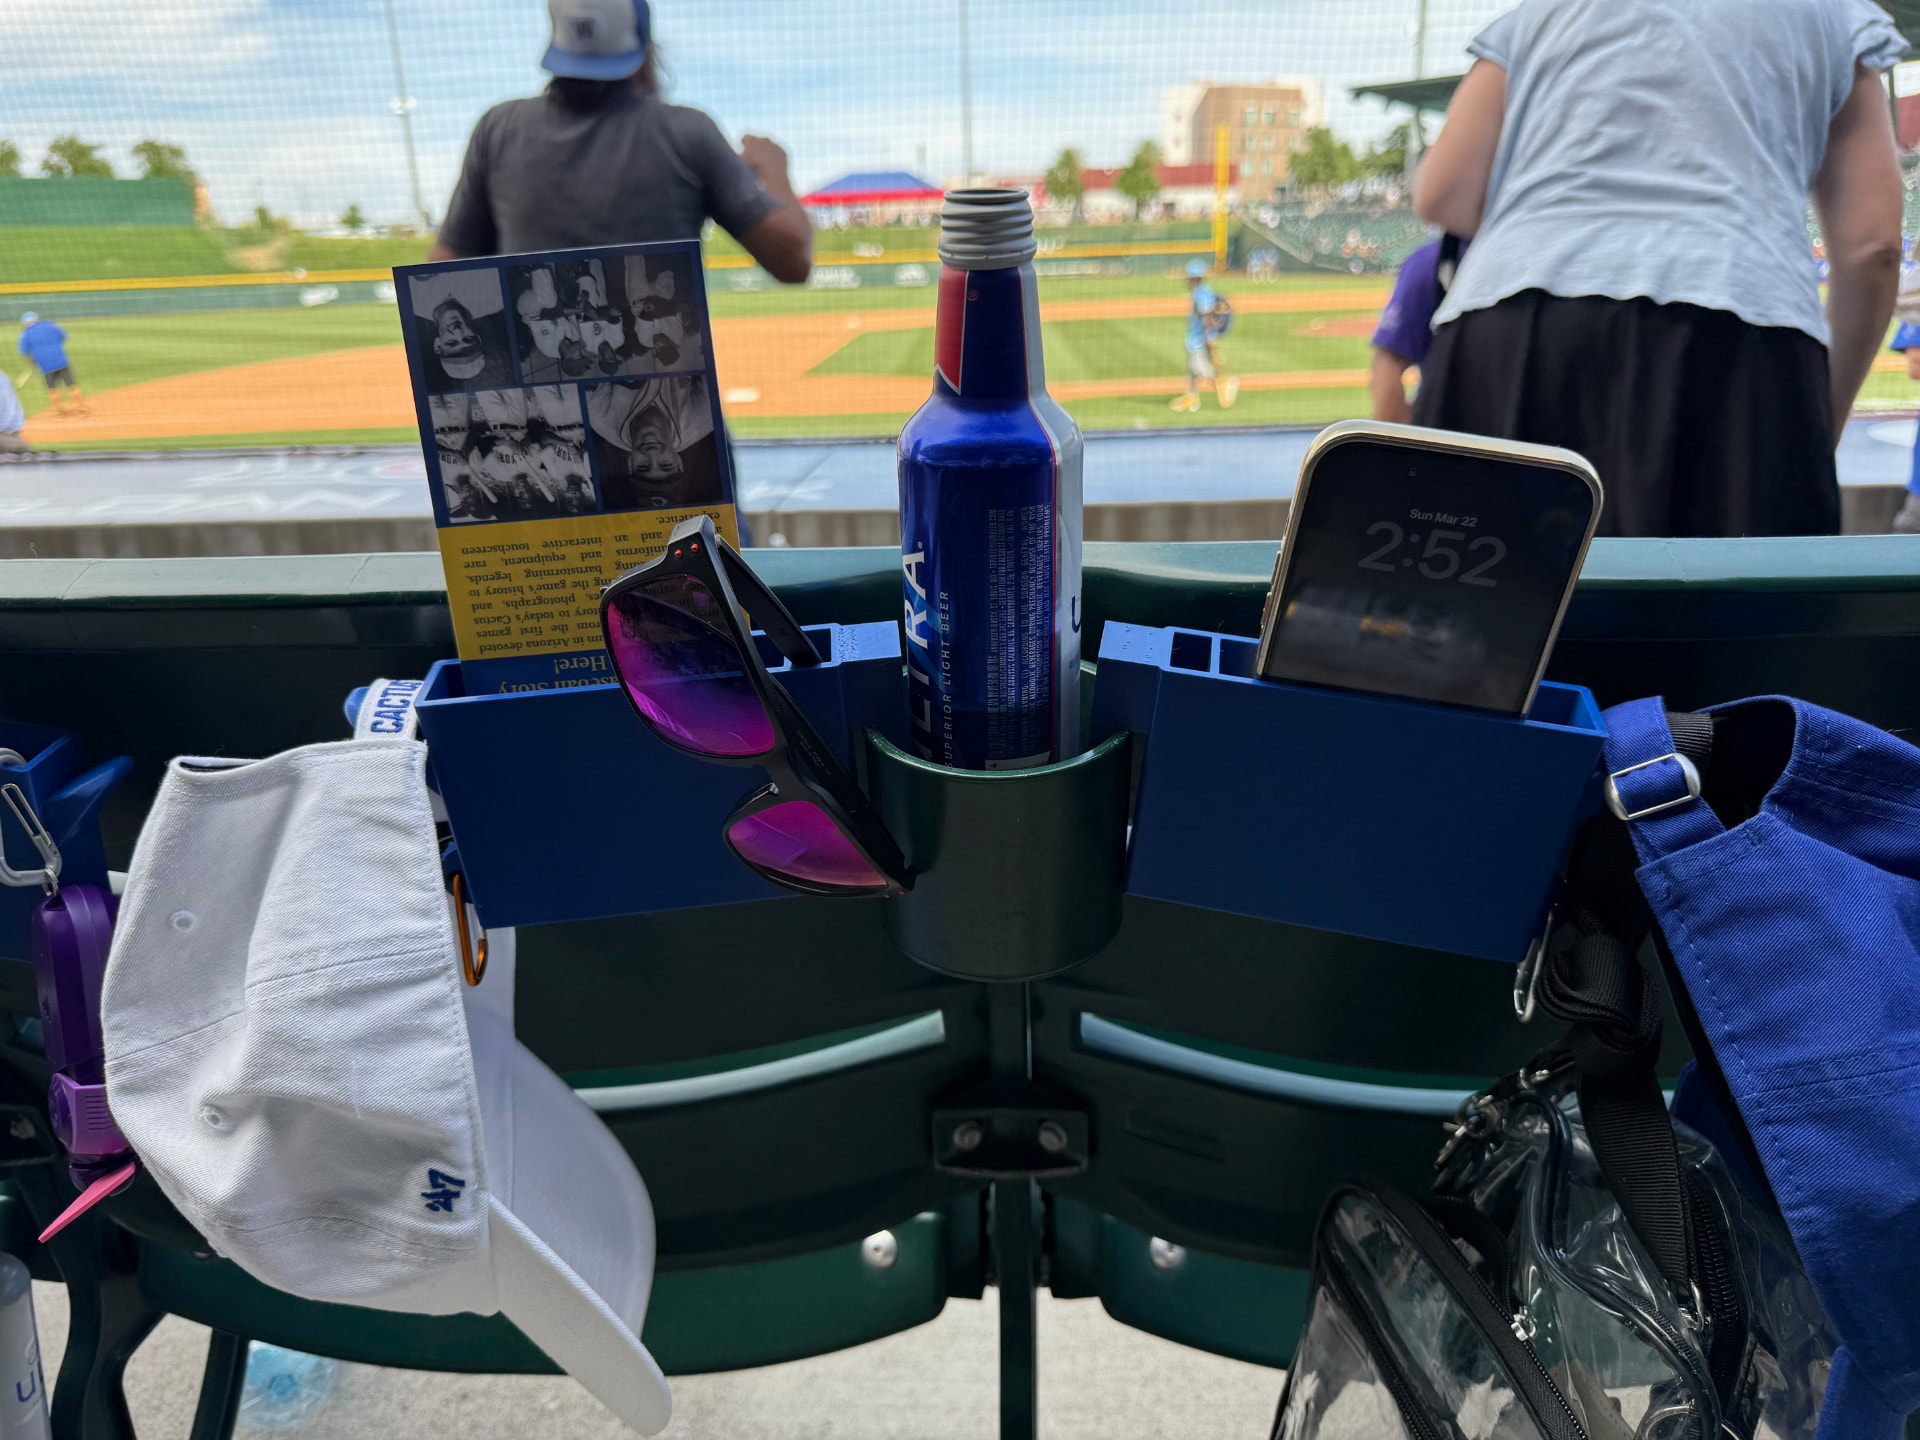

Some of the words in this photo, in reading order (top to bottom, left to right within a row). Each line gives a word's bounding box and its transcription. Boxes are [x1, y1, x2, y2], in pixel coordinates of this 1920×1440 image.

[1028, 505, 1036, 520] RISK
[1409, 508, 1432, 521] Sun
[1435, 512, 1459, 525] Mar
[1460, 515, 1478, 528] 22
[1028, 522, 1036, 534] THE
[614, 534, 628, 543] an
[641, 532, 662, 542] and
[1028, 537, 1036, 545] OF
[461, 543, 530, 555] touchscreen
[542, 537, 602, 550] interactive
[501, 552, 566, 566] equipment,
[581, 551, 602, 562] and
[1357, 520, 1507, 588] 2:52
[464, 560, 487, 569] rare
[1028, 547, 1036, 574] BECAUSE
[466, 571, 512, 585] legends,
[524, 565, 603, 580] barnstorming
[485, 586, 524, 596] history
[529, 580, 566, 594] game's
[571, 580, 589, 590] the
[469, 589, 480, 597] to
[1028, 576, 1036, 610] PREGNANCY
[502, 593, 576, 610] photographs,
[472, 603, 493, 613] and
[939, 591, 950, 631] BEER
[474, 615, 511, 625] Cactus
[516, 611, 554, 623] today's
[559, 610, 570, 619] to
[552, 624, 569, 634] the
[577, 621, 600, 630] rom
[1021, 619, 1028, 628] TO
[1028, 612, 1036, 635] DURING
[476, 626, 512, 638] games
[520, 626, 543, 636] first
[1036, 629, 1043, 637] OF
[479, 642, 523, 654] devoted
[526, 638, 569, 649] Arizona
[573, 637, 585, 647] in
[1021, 631, 1029, 664] ACCORDING
[1028, 636, 1036, 669] BEVERAGES
[553, 656, 607, 675] Here!
[941, 640, 951, 686] LIGHT
[1028, 669, 1036, 700] ALCOHOLIC
[943, 694, 953, 768] SUPERIOR
